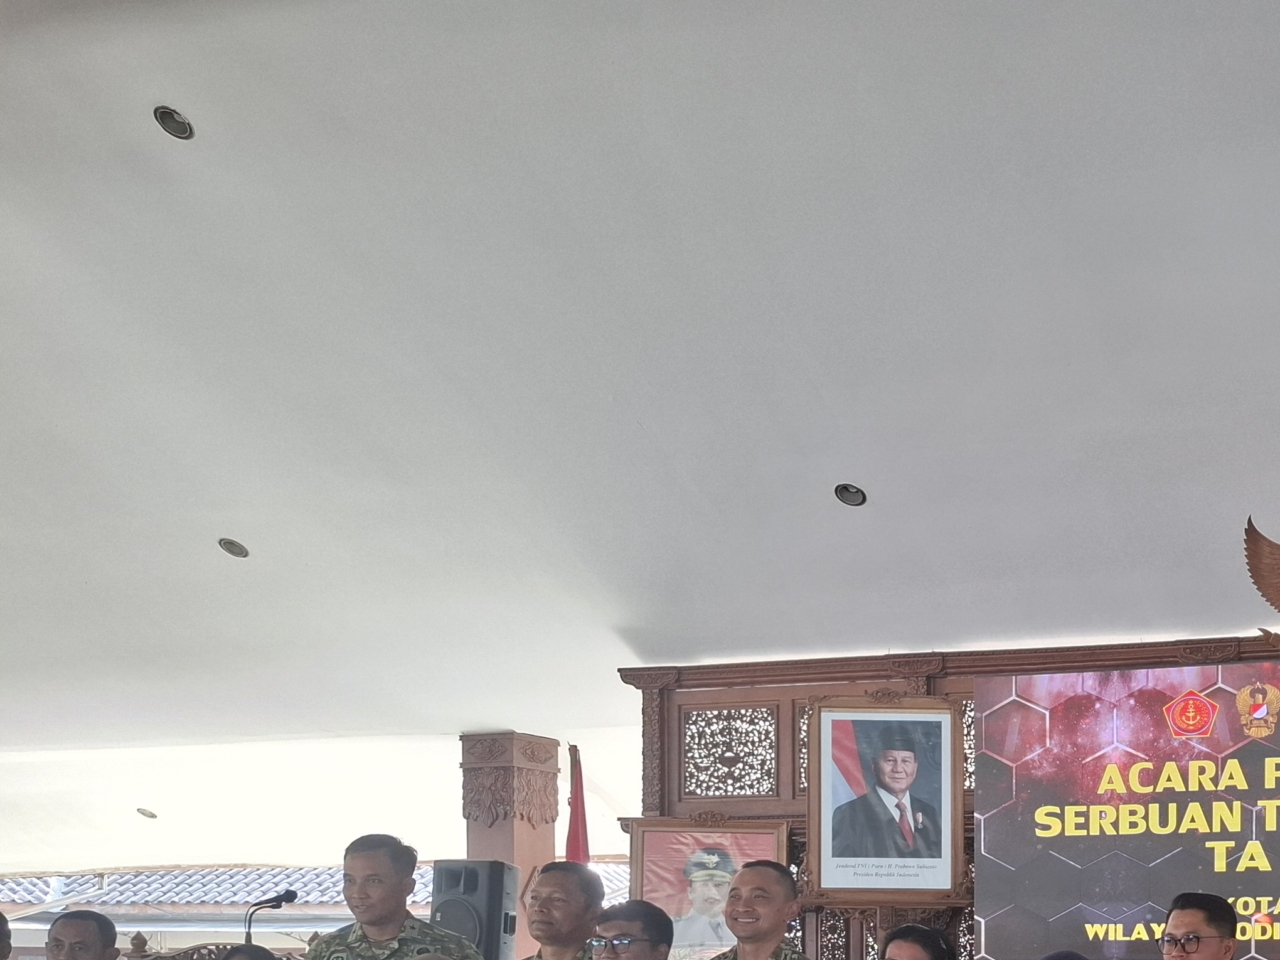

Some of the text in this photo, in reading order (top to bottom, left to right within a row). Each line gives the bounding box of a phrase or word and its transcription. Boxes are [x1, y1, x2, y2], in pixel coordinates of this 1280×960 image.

[1097, 758, 1249, 794] ACARA
[1034, 800, 1242, 838] SERBUAN
[1205, 840, 1272, 872] TA
[1084, 923, 1166, 941] WILAY
